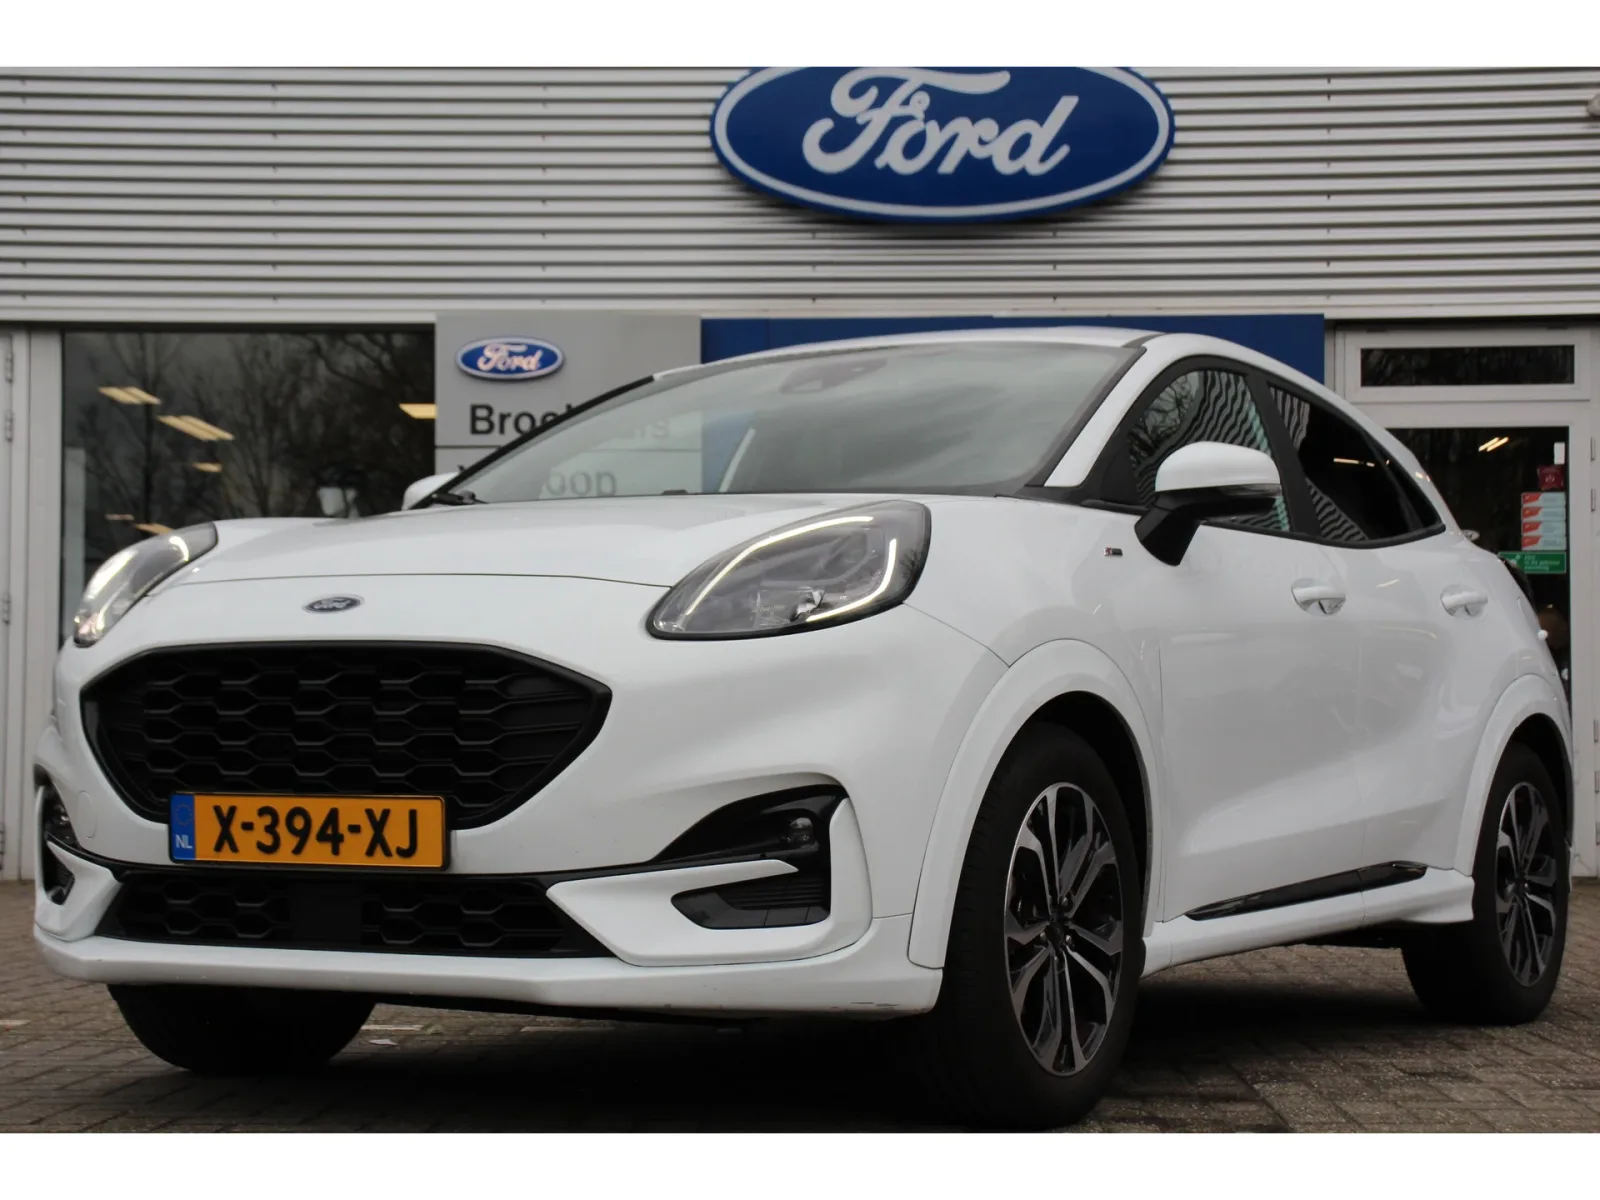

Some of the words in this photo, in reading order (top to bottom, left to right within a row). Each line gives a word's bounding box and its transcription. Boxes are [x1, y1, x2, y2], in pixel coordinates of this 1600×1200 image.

[802, 68, 1079, 176] Ford
[477, 343, 544, 371] Ford
[175, 833, 193, 849] NL
[212, 805, 418, 858] X-394-XJ
